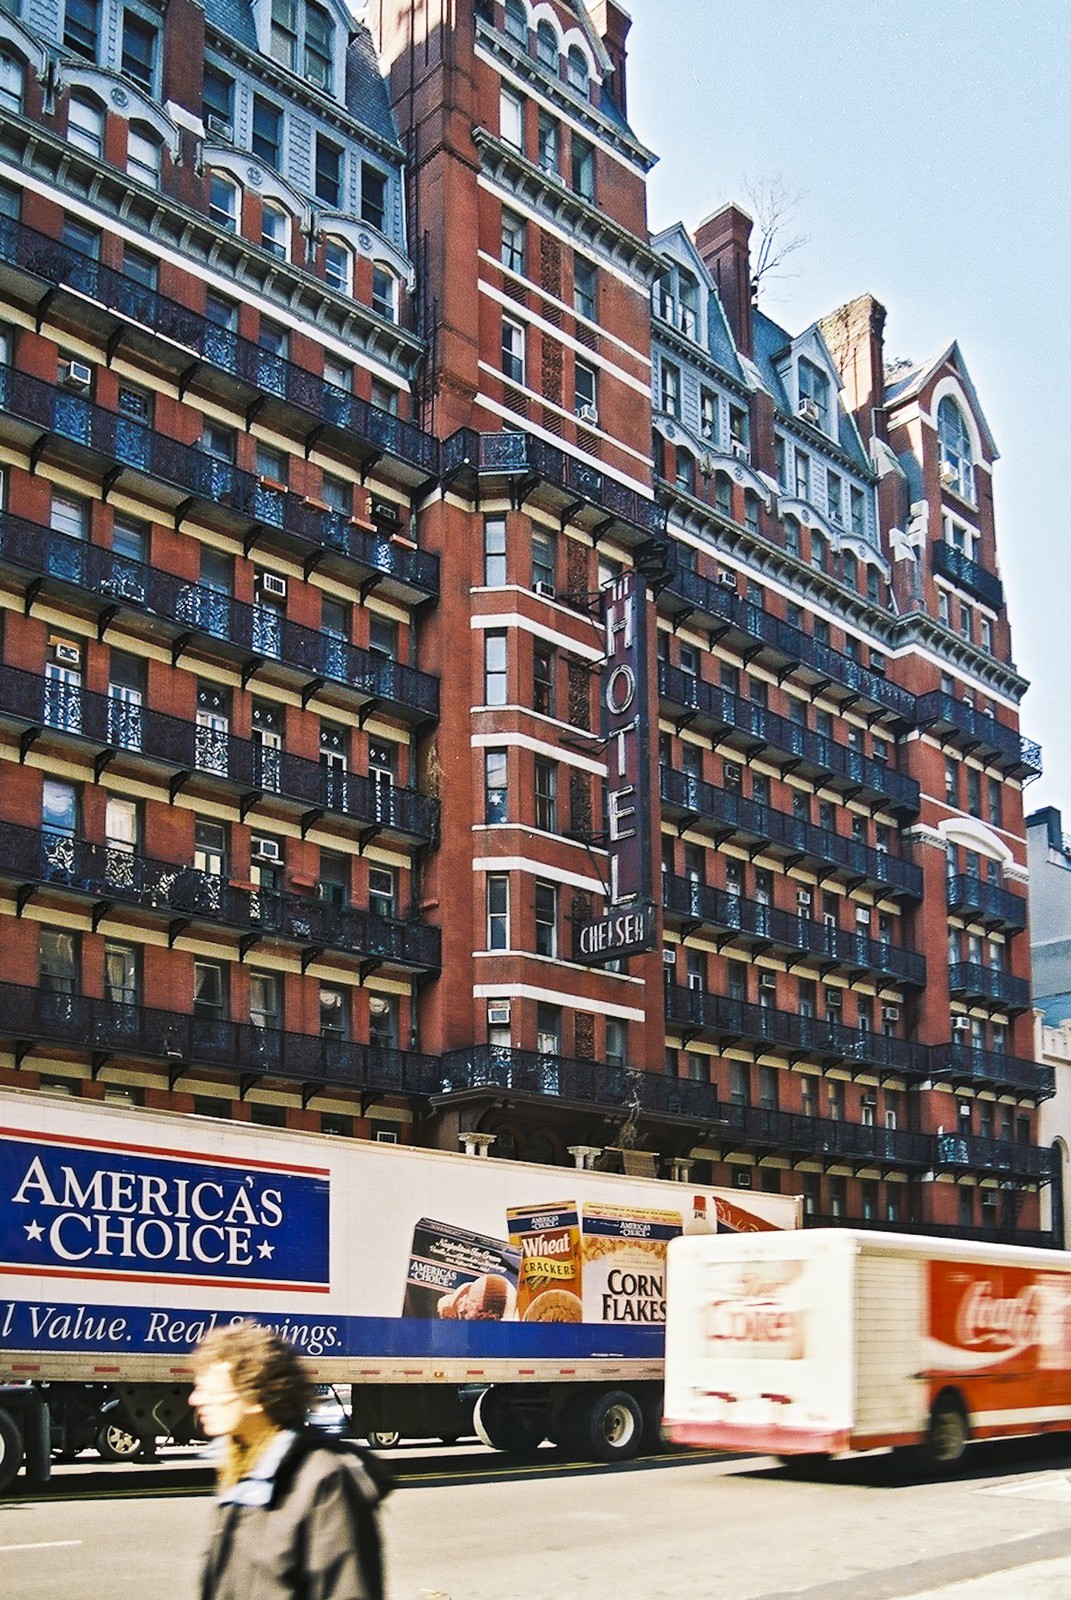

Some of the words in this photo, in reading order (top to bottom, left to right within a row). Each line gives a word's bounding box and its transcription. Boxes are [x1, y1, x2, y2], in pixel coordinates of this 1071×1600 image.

[606, 596, 637, 906] HOTEL
[580, 913, 644, 954] CHELSEA
[11, 1155, 283, 1227] AMERICA'S
[50, 1212, 253, 1266] CHOICE
[521, 1232, 571, 1258] Wheat
[414, 1271, 449, 1287] CHOICE
[523, 1261, 576, 1275] CRACKERS
[607, 1268, 663, 1298] CORN
[28, 1306, 132, 1342] Value.
[144, 1312, 217, 1344] Real
[602, 1293, 666, 1323] FLAKES
